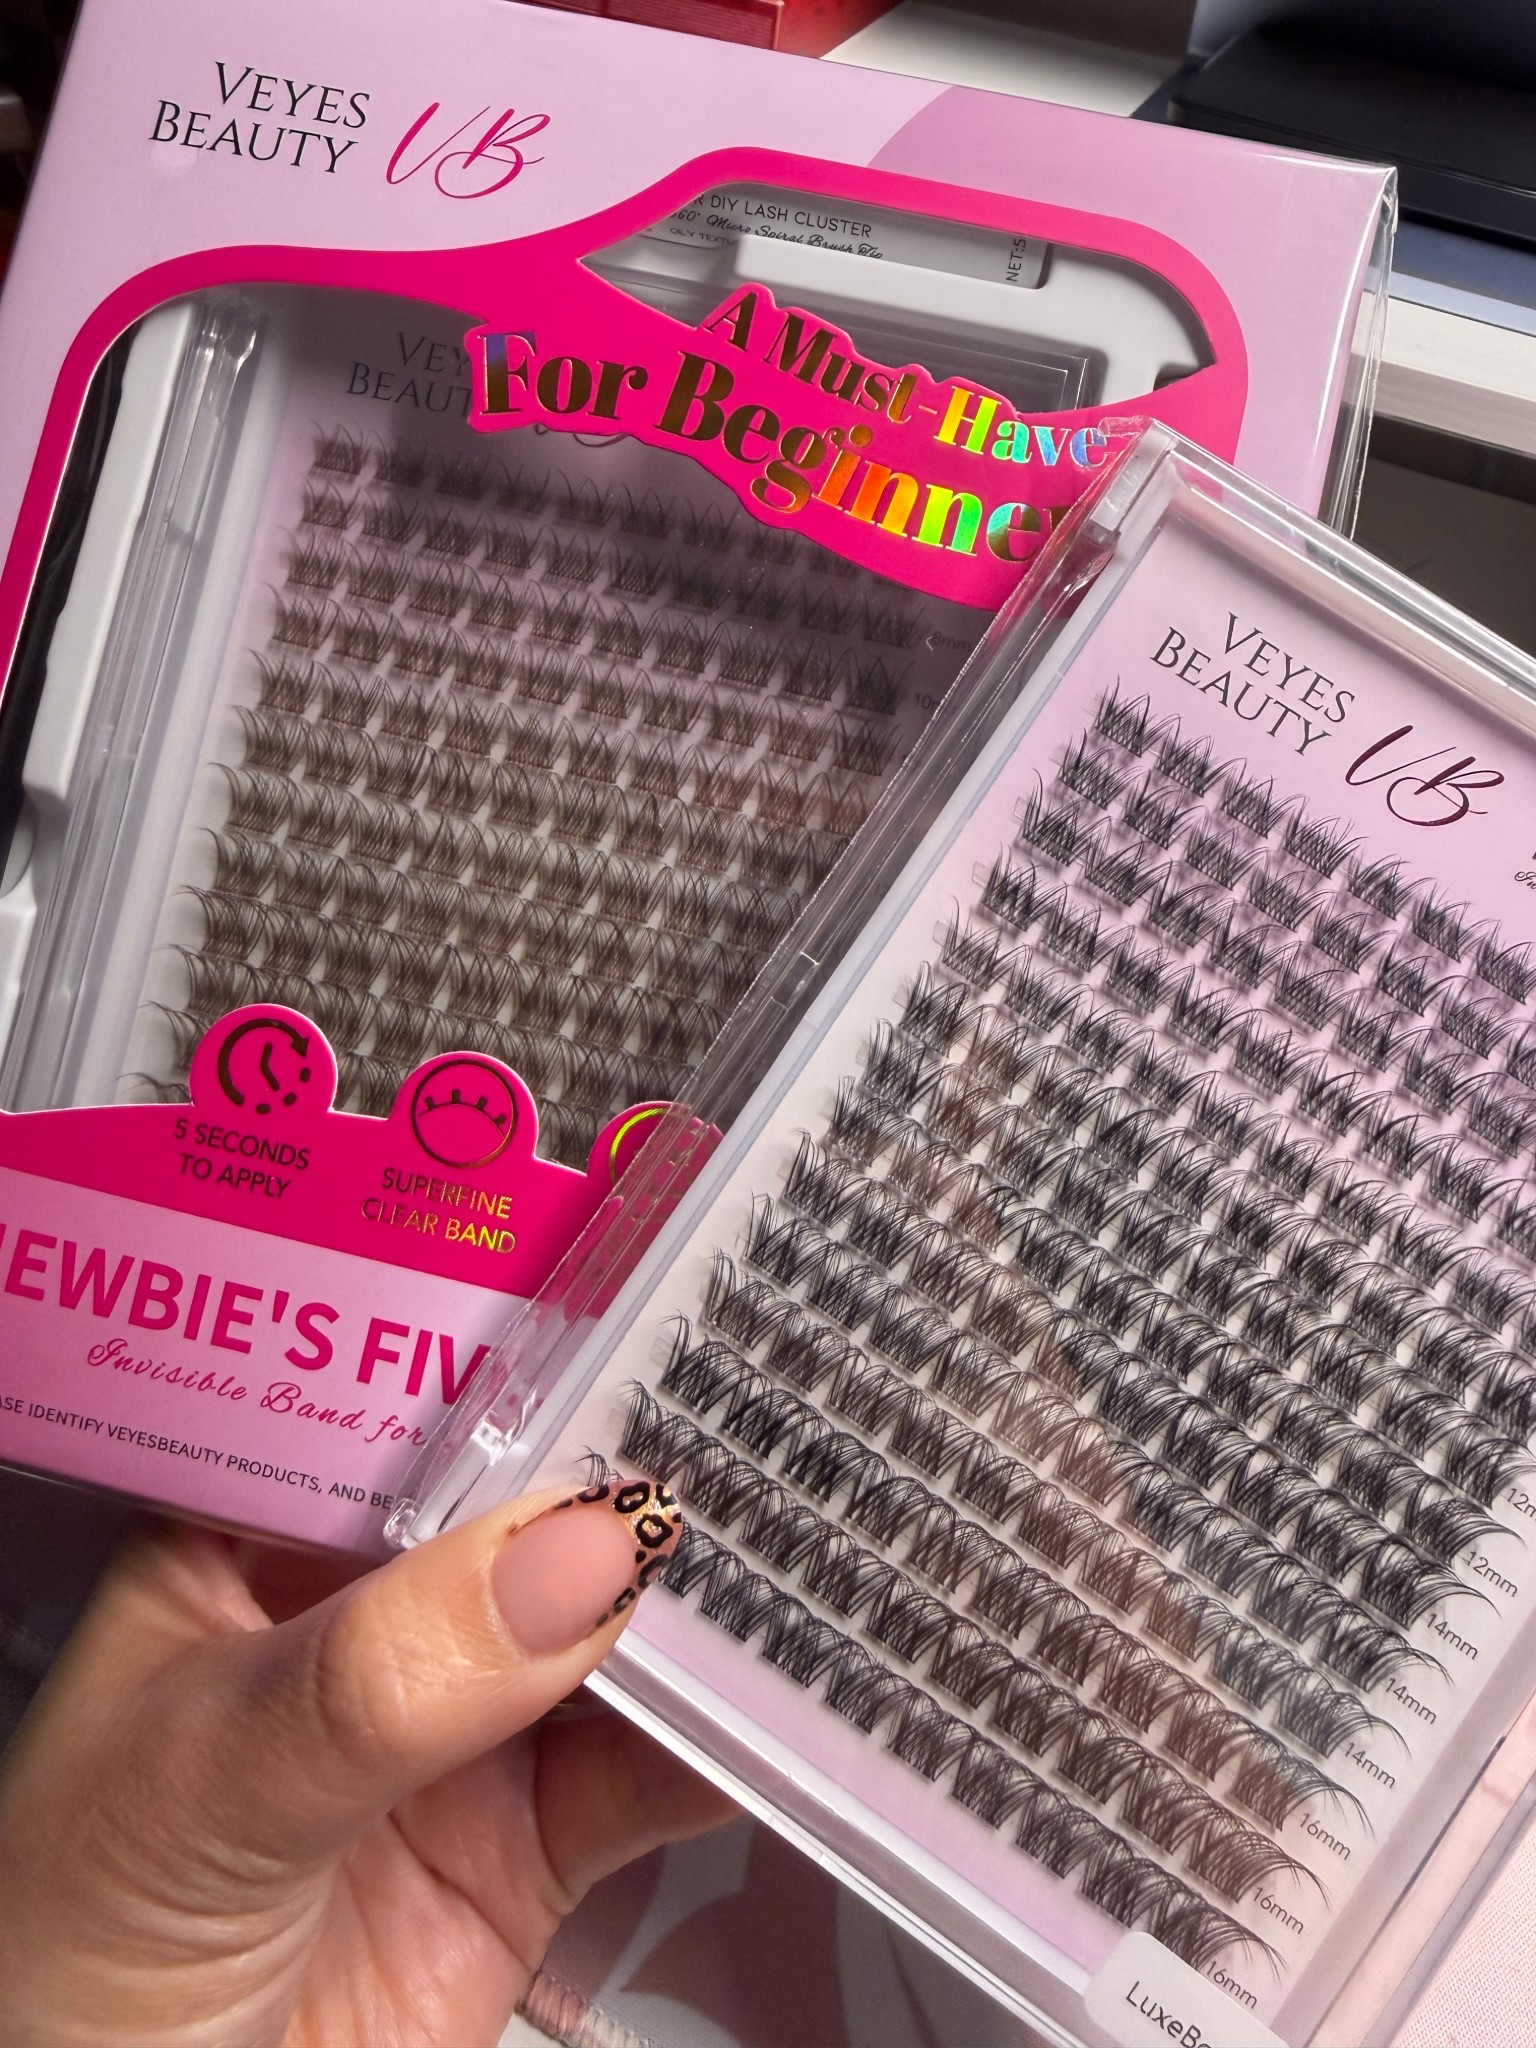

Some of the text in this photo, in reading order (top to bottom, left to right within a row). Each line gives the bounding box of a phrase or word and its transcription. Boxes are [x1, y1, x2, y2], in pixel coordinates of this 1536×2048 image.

[215, 61, 370, 129] VEYES
[148, 100, 358, 173] BEAUTY
[386, 102, 551, 199] VB
[670, 208, 702, 222] 60°
[706, 214, 752, 234] Micro
[711, 194, 739, 211] DIY
[745, 200, 788, 222] LASH
[794, 211, 872, 238] CLUSTER
[475, 331, 649, 421] For
[706, 292, 1110, 468] A Must-Have
[1149, 626, 1333, 757] BEAUTY
[1224, 612, 1356, 723] VEYES
[1345, 725, 1505, 826] VB
[175, 1119, 310, 1170] 5 SECONDS
[180, 1152, 292, 1199] TO APPLY
[380, 1167, 514, 1220] SUPERFINE
[360, 1198, 517, 1255] CLEAR BAND
[0, 1223, 492, 1406] EWBIE'S FIV
[87, 1337, 428, 1446] Invisible Band for
[0, 1395, 24, 1414] SE
[28, 1403, 104, 1434] IDENTIFY
[108, 1423, 224, 1466] VEYESBEAUTY
[226, 1454, 322, 1494] PRODUCTS,
[328, 1482, 365, 1502] AND
[1465, 1549, 1519, 1597] 12mm
[1428, 1612, 1479, 1660] 14mm
[1386, 1677, 1437, 1725] 14mm
[1345, 1741, 1396, 1789] 14mm
[1300, 1812, 1351, 1861] 16mm
[1252, 1886, 1304, 1935] 16mm
[1206, 1960, 1258, 2010] 16mm
